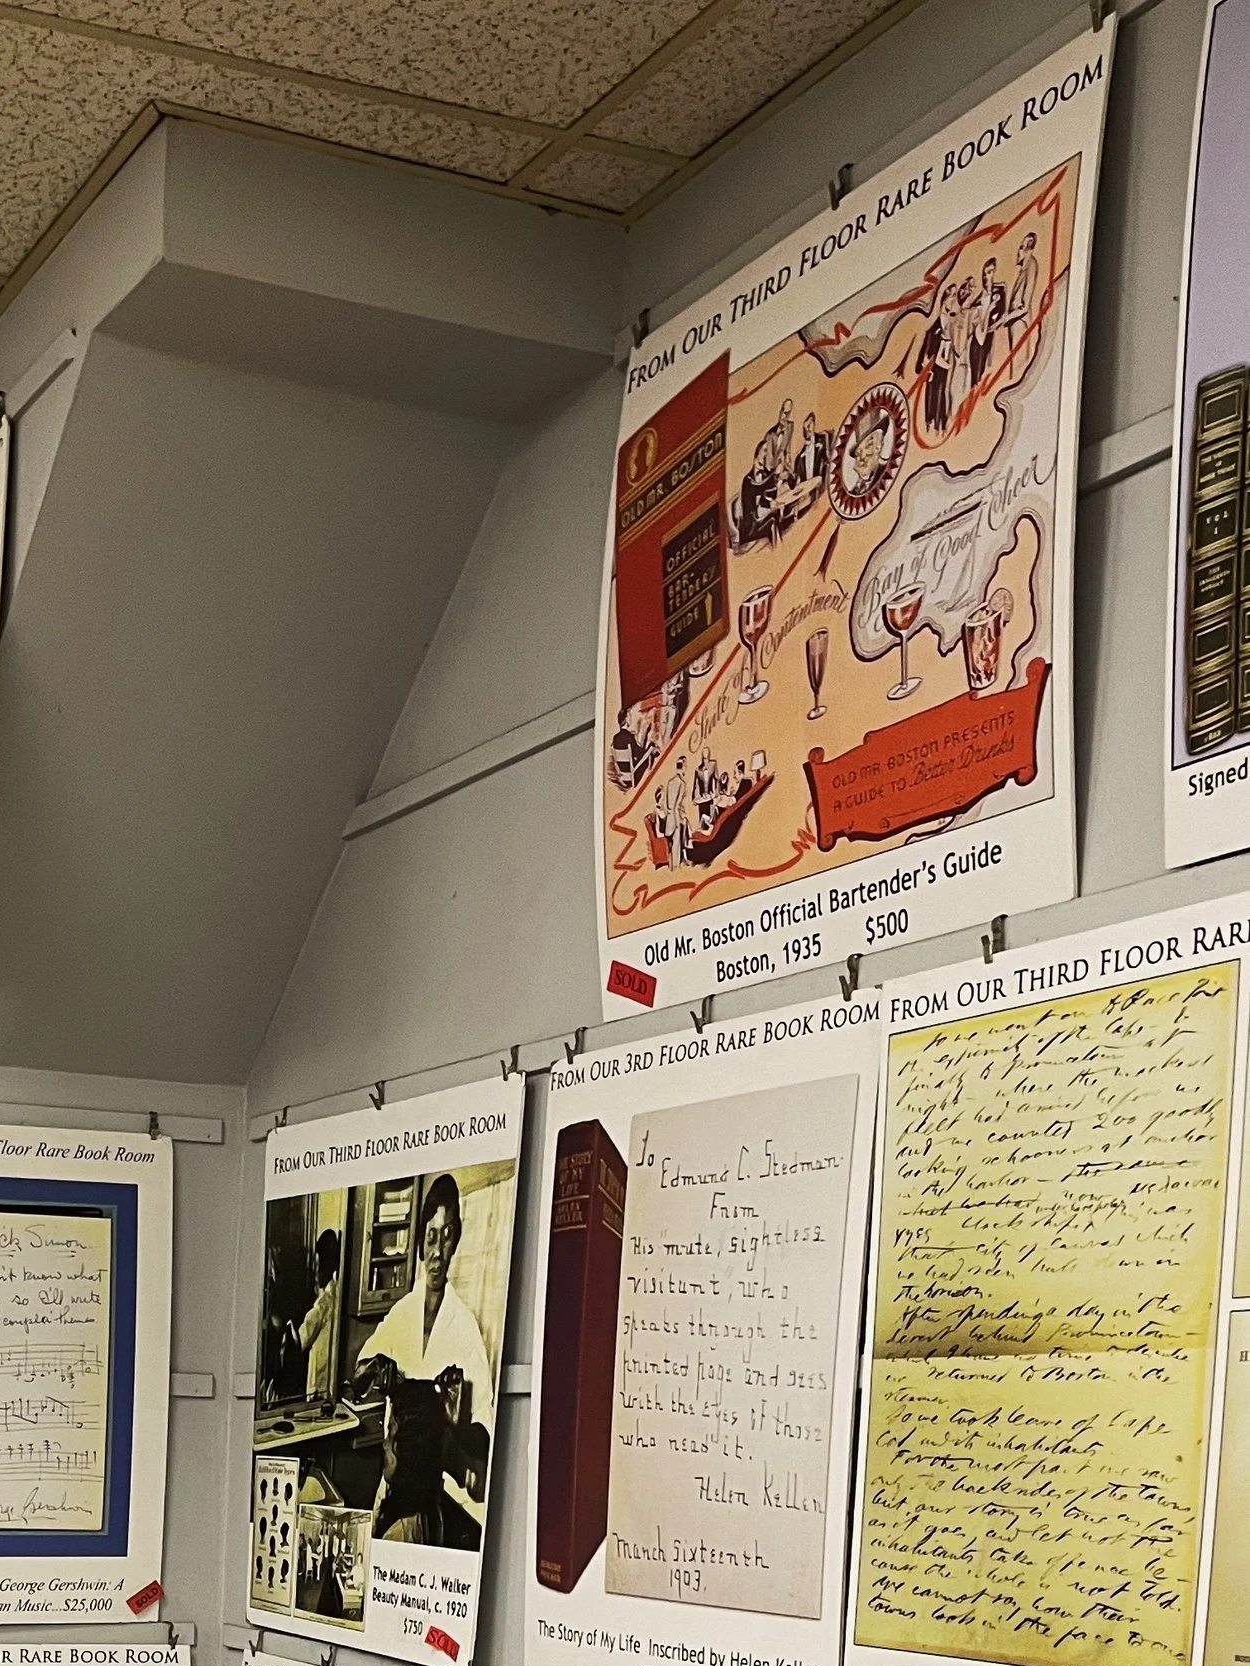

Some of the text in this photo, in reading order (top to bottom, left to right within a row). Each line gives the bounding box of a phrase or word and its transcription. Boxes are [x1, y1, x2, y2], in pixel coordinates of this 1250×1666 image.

[628, 54, 1102, 394] FROM OUR THIRD FLOOR RARE BOOK ROOM
[1189, 757, 1248, 796] Signed
[645, 841, 1001, 966] Old Mr. Boston Official Bartender's Guide
[717, 909, 908, 982] Boston, 1935 $500
[0, 1579, 45, 1595] George
[114, 1579, 124, 1590] A
[373, 1566, 471, 1595] The Madam C. J. Walker
[373, 1587, 398, 1608] Beauty
[401, 1593, 431, 1614] Manual,
[447, 1601, 467, 1618] 1920
[404, 1617, 422, 1635] $750
[538, 1620, 555, 1638] The
[558, 1623, 583, 1647] Story
[587, 1629, 597, 1646] of
[601, 1632, 615, 1653] My
[619, 1634, 640, 1653] Life
[649, 1639, 704, 1664] Inscribed
